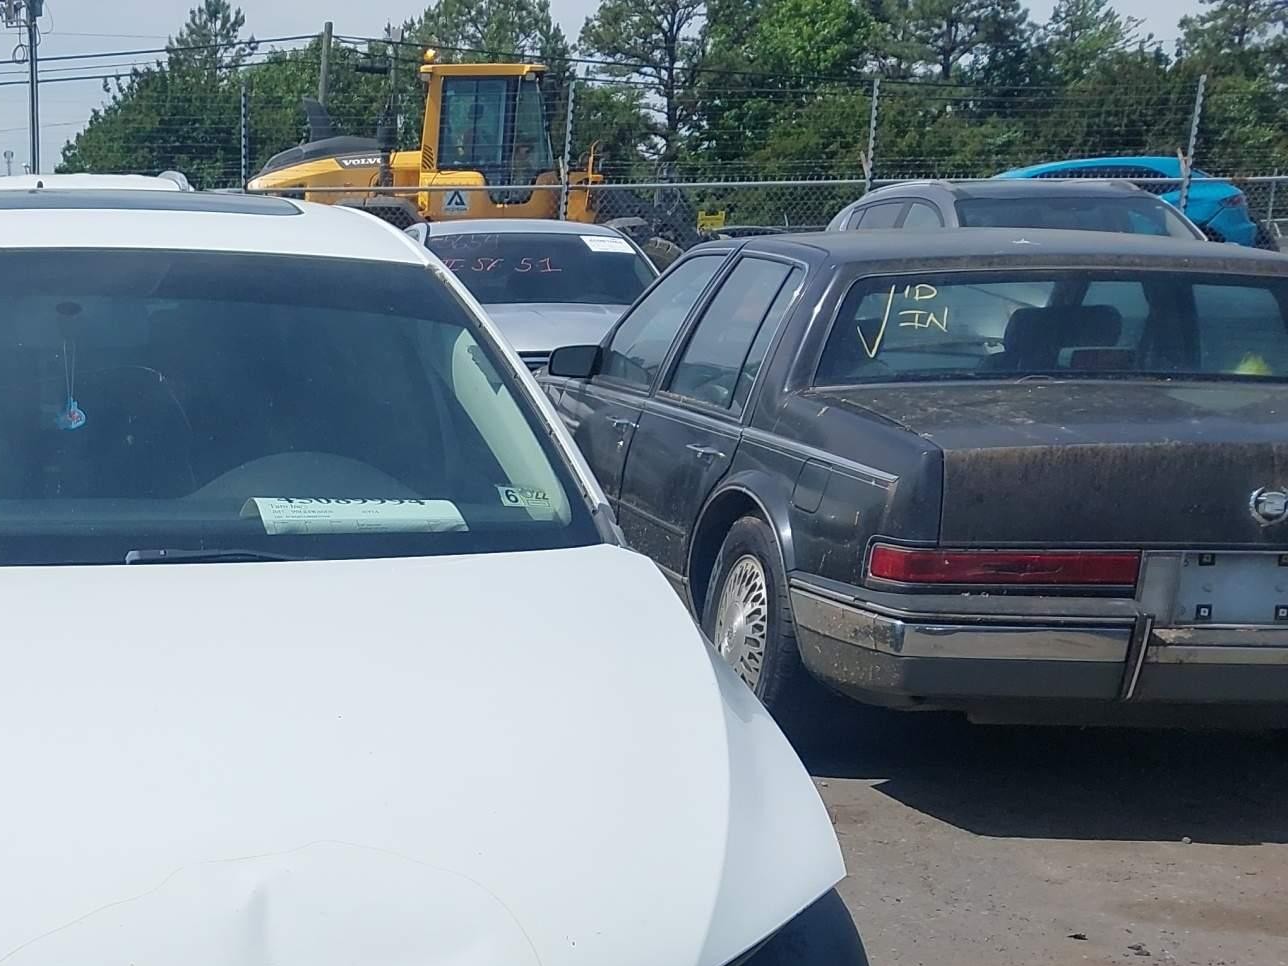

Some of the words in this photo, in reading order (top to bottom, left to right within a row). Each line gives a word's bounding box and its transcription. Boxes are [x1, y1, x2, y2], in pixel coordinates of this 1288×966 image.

[904, 284, 938, 300] ID
[898, 306, 949, 333] IN
[505, 489, 519, 503] 6
